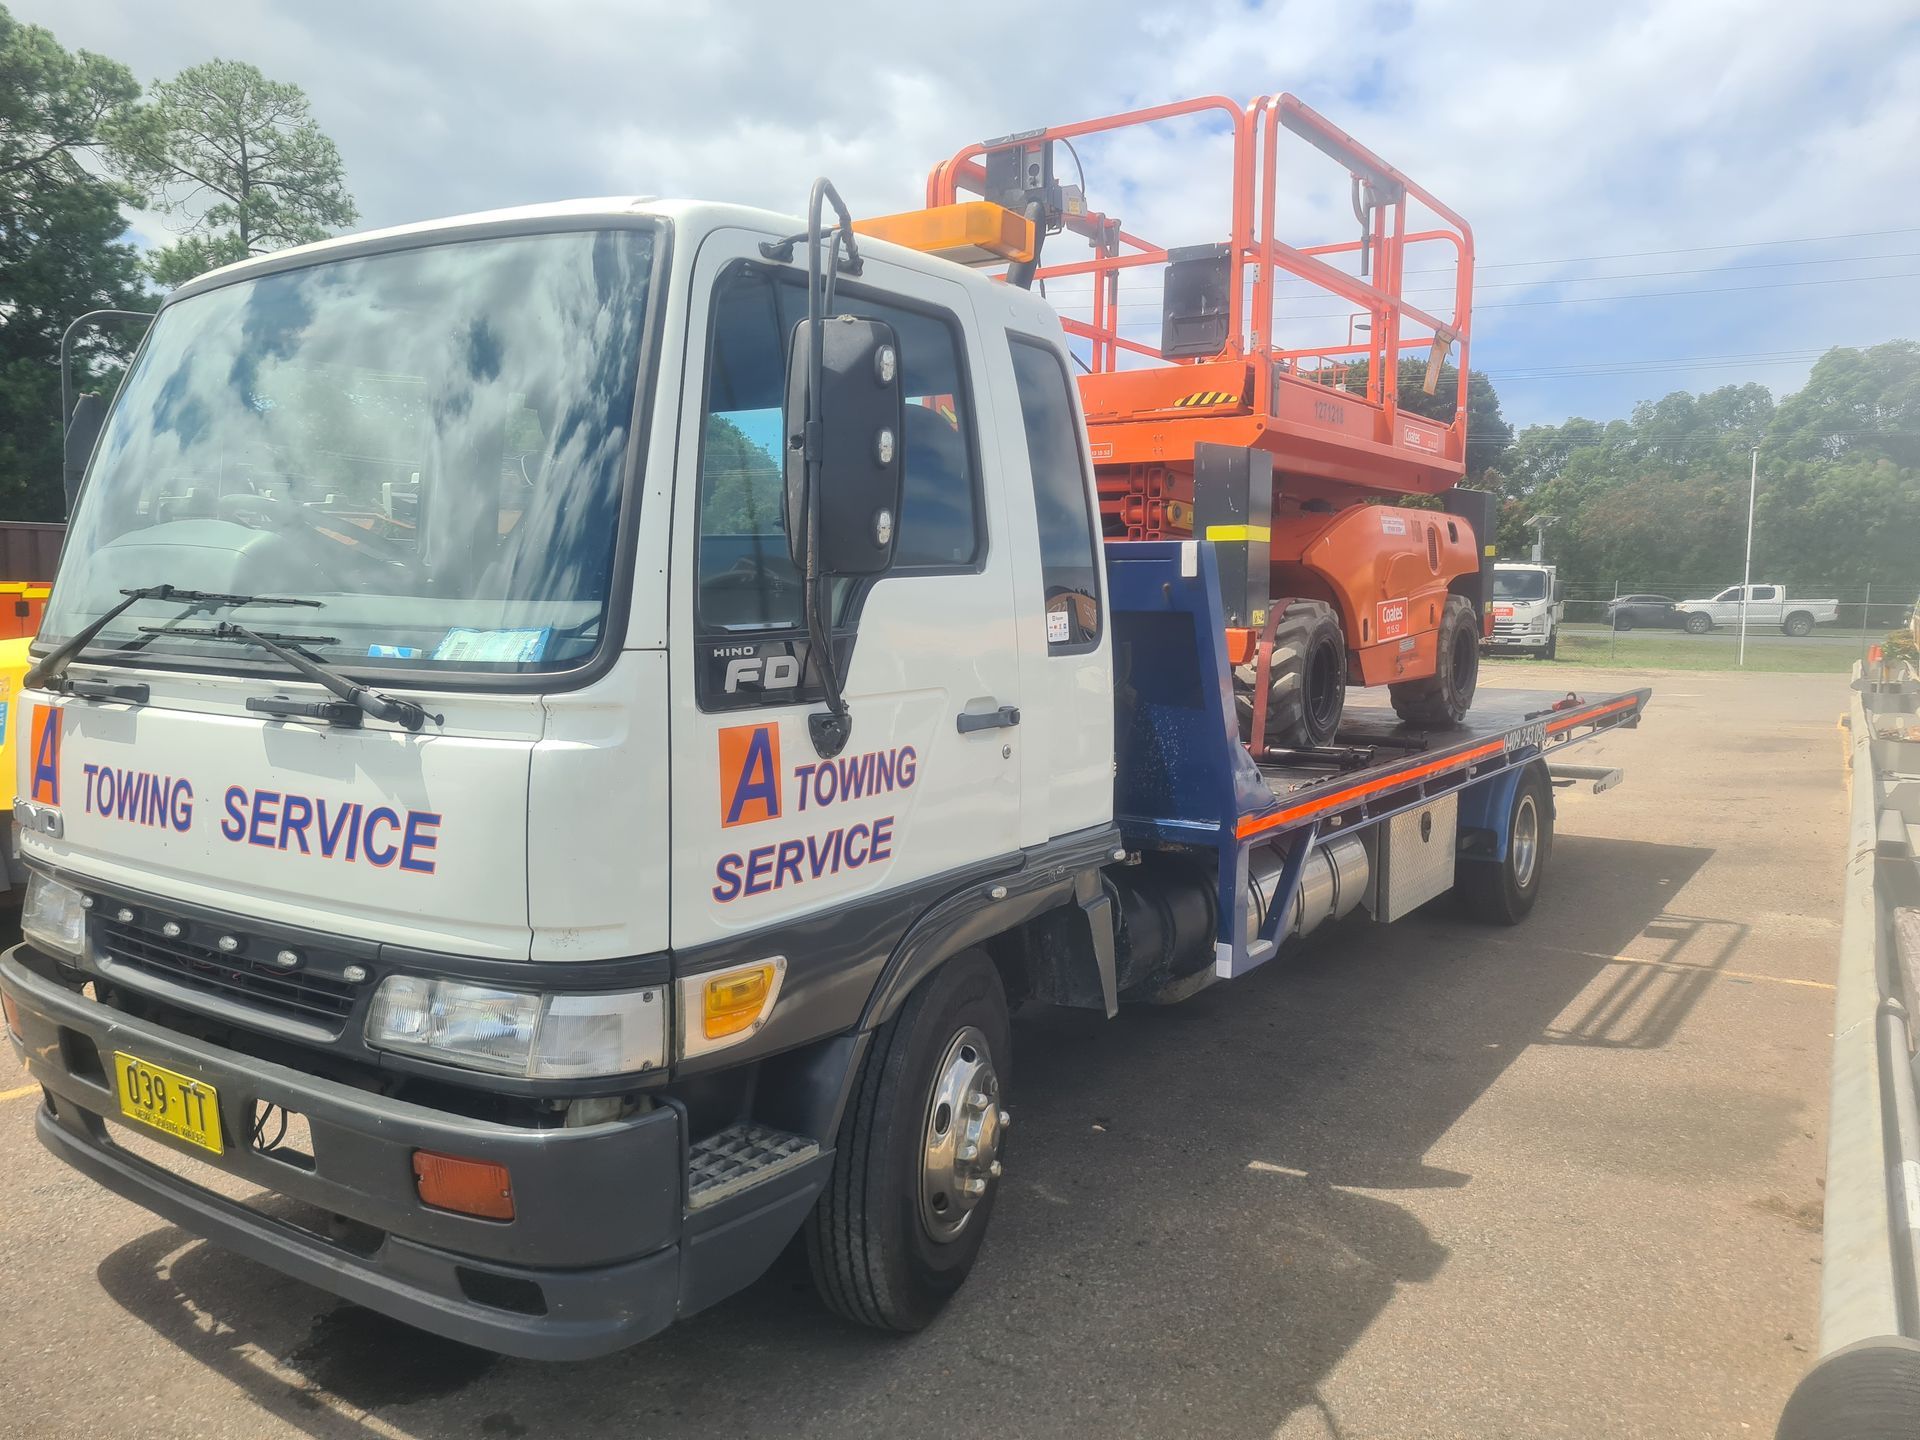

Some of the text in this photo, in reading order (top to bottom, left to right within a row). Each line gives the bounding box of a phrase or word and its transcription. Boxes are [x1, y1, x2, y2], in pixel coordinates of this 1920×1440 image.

[1383, 605, 1403, 623] Coates
[713, 646, 754, 658] HINO
[724, 656, 799, 693] FD
[1503, 729, 1520, 753] 0409
[32, 708, 442, 875] A TOWING SERVICE
[726, 728, 917, 824] A TOWING
[712, 815, 895, 904] SERVICE
[152, 1114, 179, 1133] SOUTH
[182, 1125, 207, 1145] WALES
